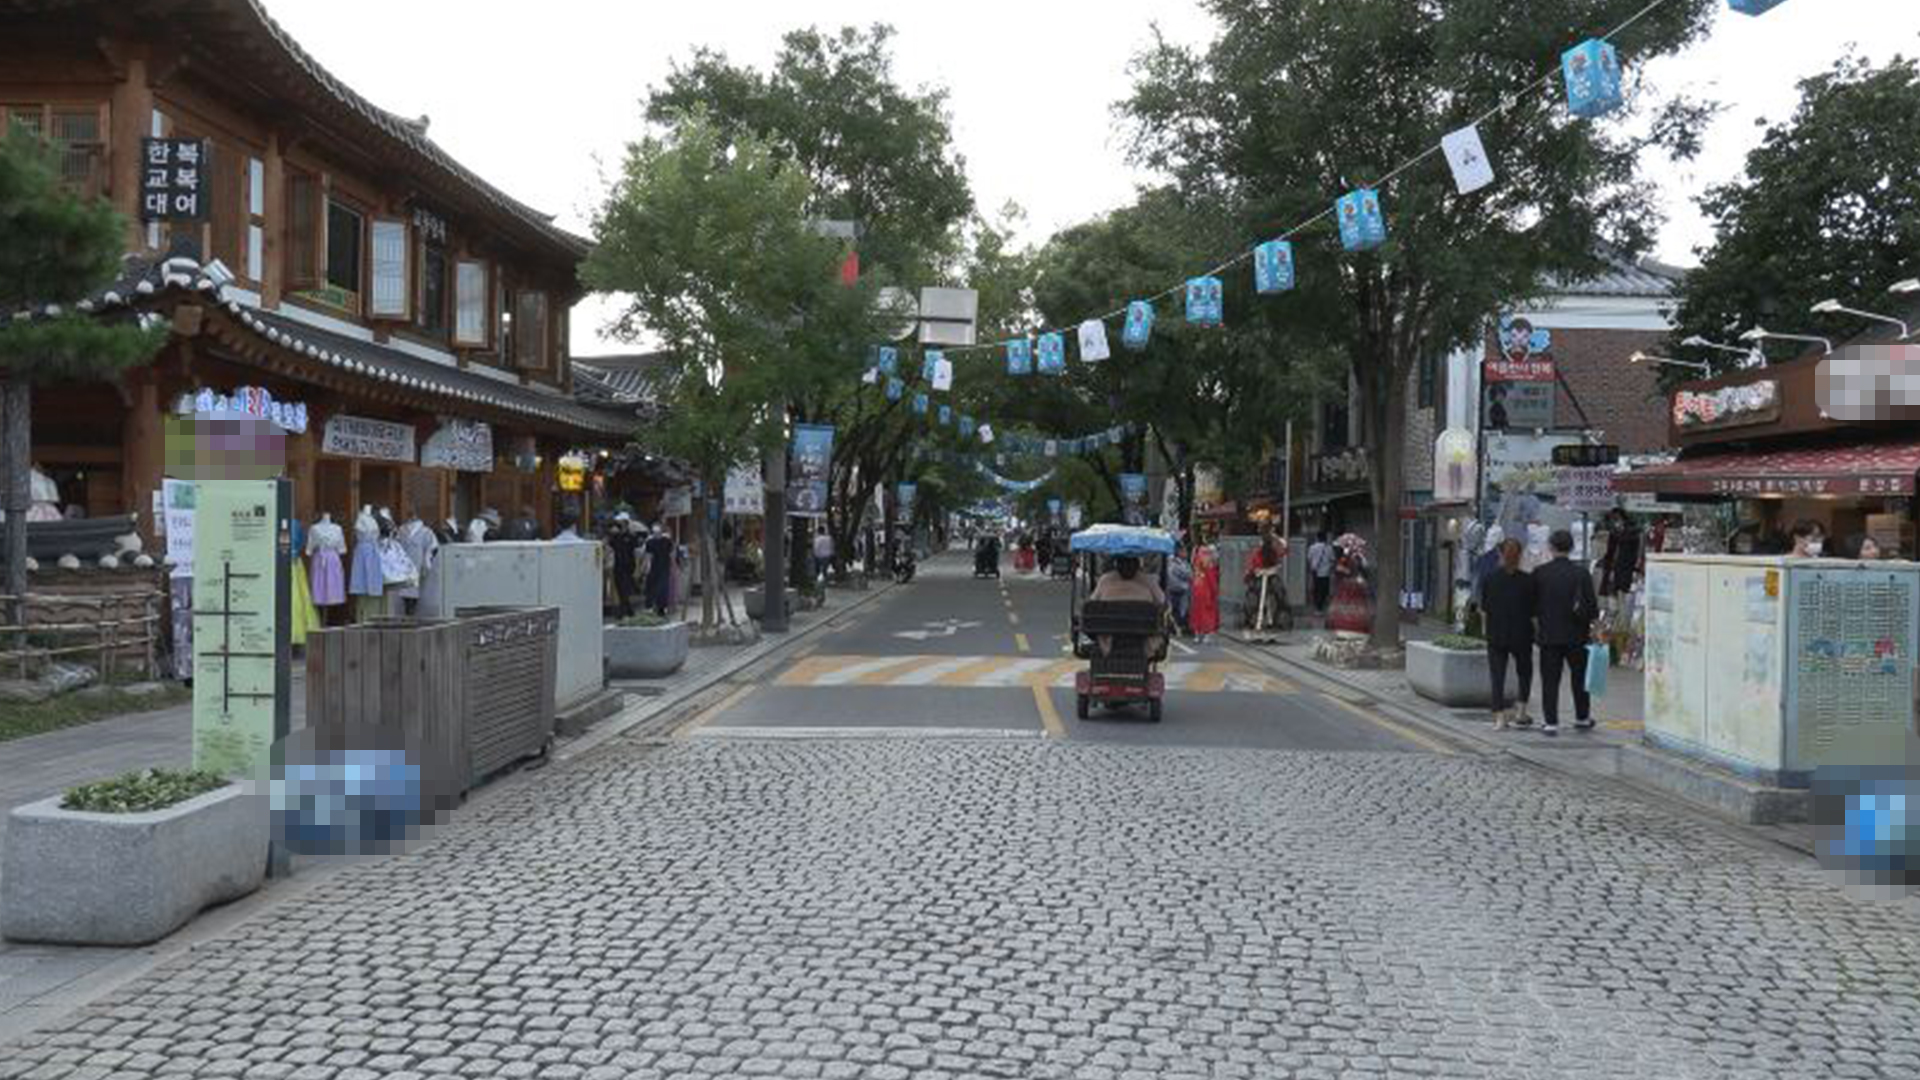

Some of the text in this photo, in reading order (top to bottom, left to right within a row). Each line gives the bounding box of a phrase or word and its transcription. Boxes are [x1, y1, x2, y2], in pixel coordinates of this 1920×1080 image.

[147, 141, 199, 164] 한복
[145, 167, 198, 190] 교복
[146, 192, 198, 216] 대여
